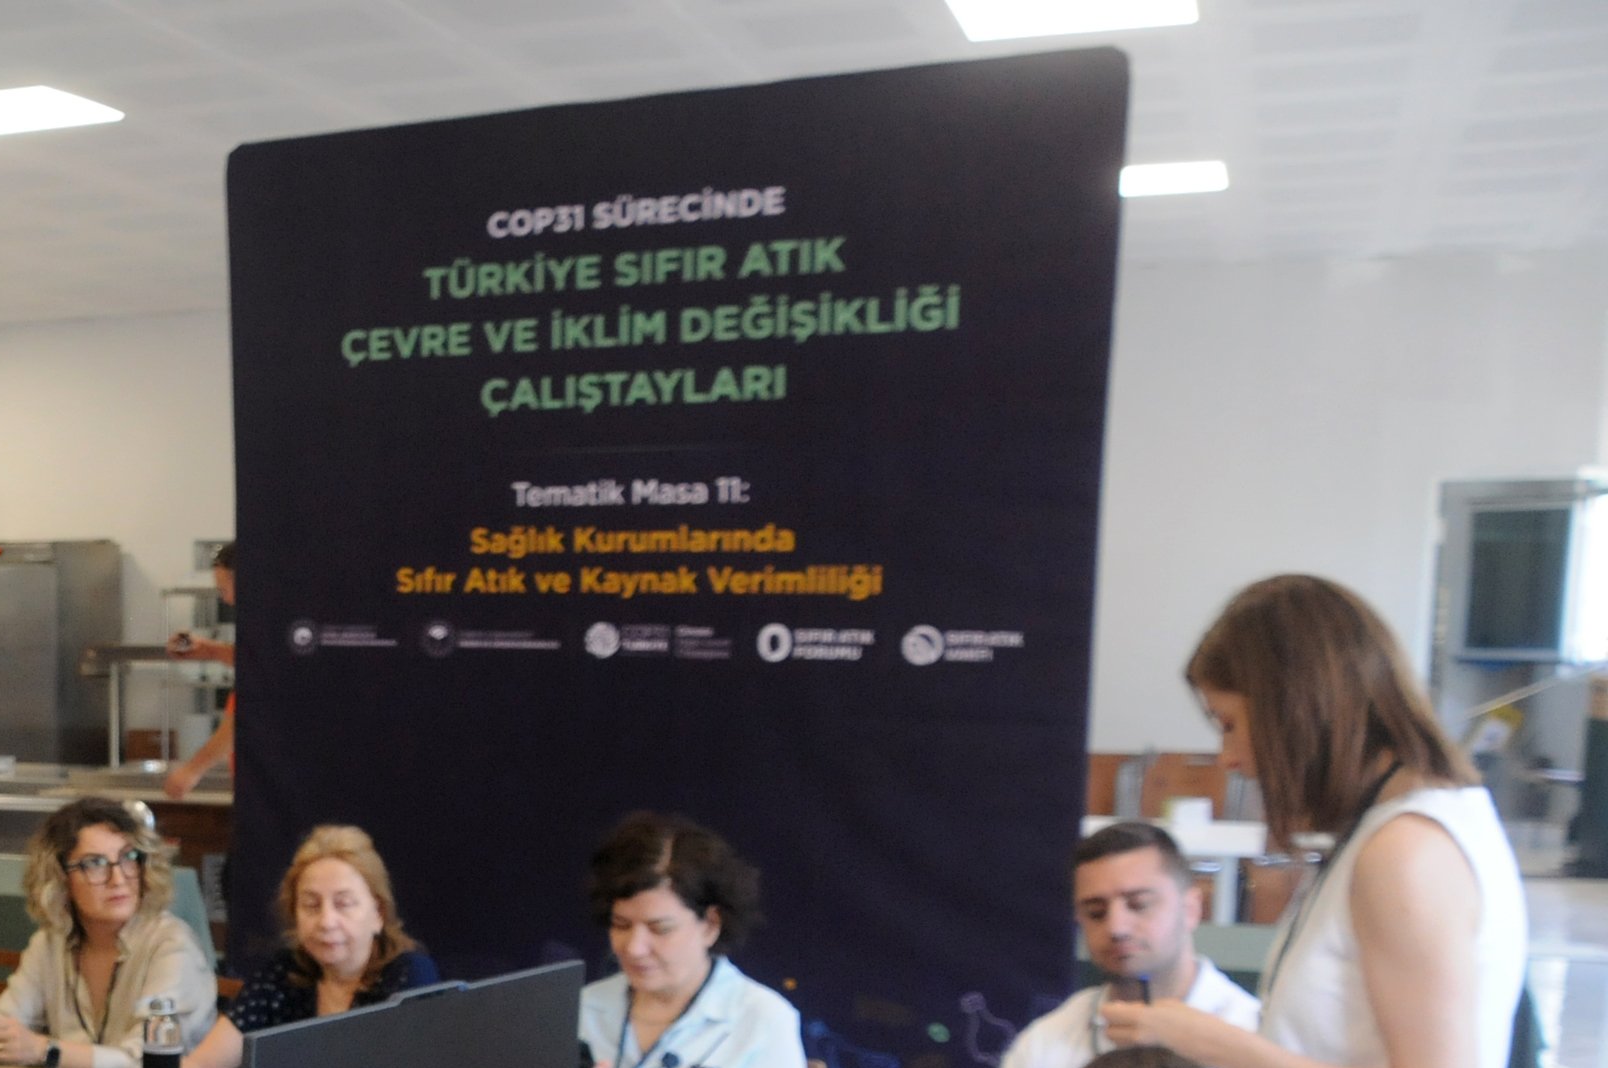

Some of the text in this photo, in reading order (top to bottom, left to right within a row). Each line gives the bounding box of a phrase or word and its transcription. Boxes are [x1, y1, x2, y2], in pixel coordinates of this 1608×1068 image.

[486, 186, 786, 239] COP31 SÜRECİNDE
[423, 237, 845, 300] TÜRKİYE SIFIR ATIK
[341, 284, 961, 367] ÇEVRE VE İKLİM DEĞİŞİKLİĞİ
[480, 365, 787, 417] ÇALIŞTAYLARI
[511, 479, 625, 508] Tematik
[631, 478, 710, 504] Masa
[470, 523, 797, 559] Sağlık Kurumlarında
[396, 566, 458, 594] Sıfır
[463, 566, 527, 594] Atık
[534, 572, 572, 594] ve
[580, 565, 698, 599] Kaynak
